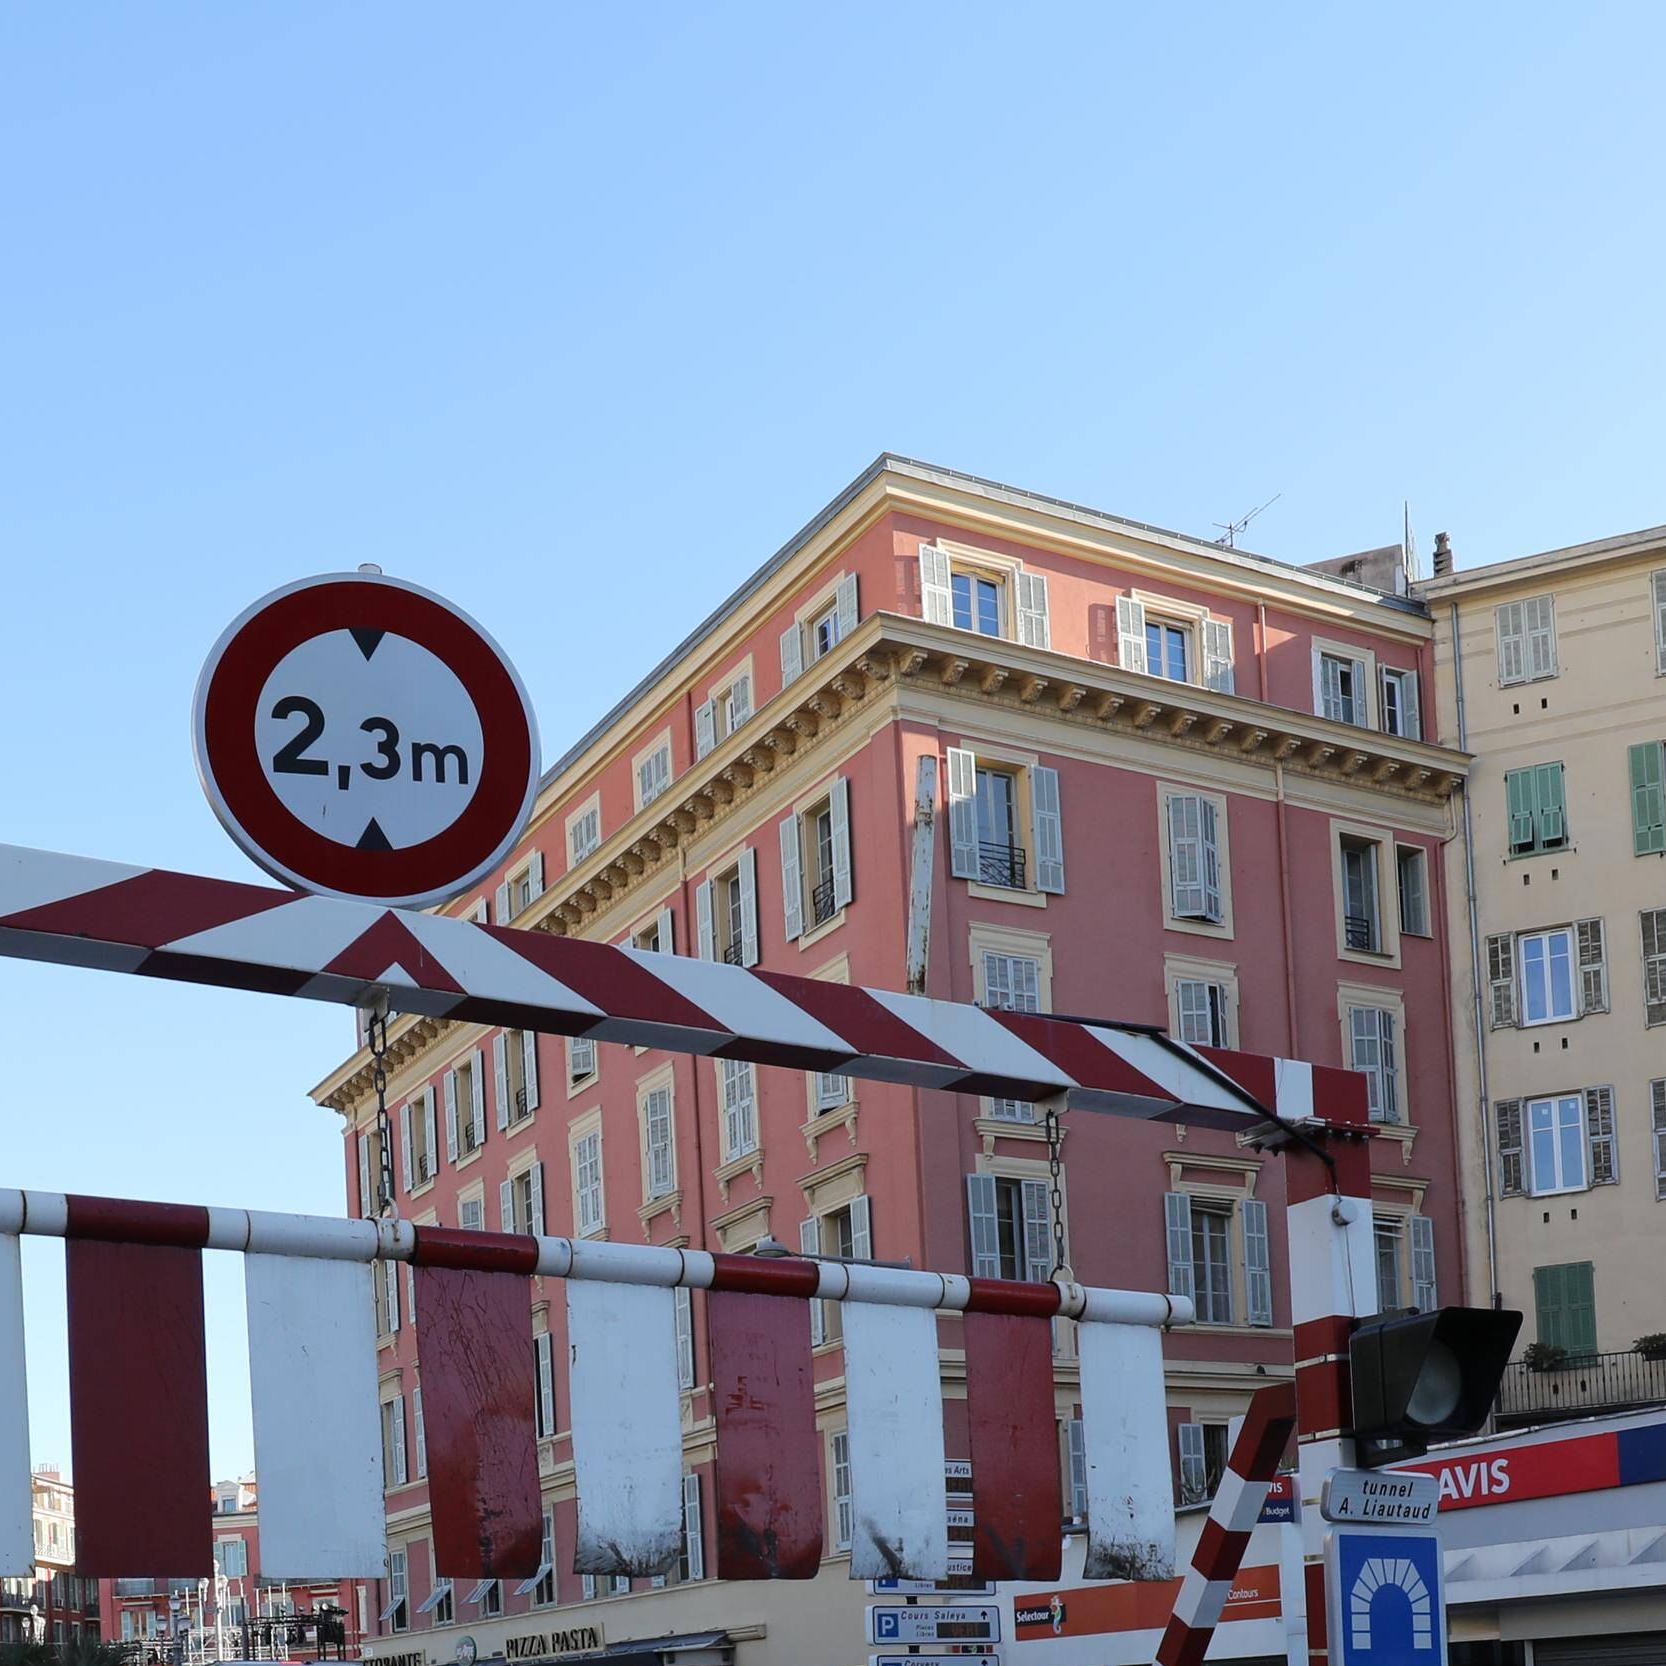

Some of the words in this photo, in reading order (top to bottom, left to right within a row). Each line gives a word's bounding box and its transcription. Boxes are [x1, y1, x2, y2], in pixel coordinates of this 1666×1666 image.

[1362, 1479, 1414, 1498] tunnel
[1439, 1458, 1511, 1502] AVIS
[1265, 1506, 1291, 1517] Budget
[1338, 1497, 1354, 1515] A.
[1363, 1501, 1431, 1520] Liautaud
[901, 1610, 929, 1620] Cours
[934, 1610, 966, 1621] Saleya
[1016, 1604, 1050, 1623] Selectour
[505, 1633, 545, 1659] PIZZA
[551, 1626, 598, 1652] PASTA
